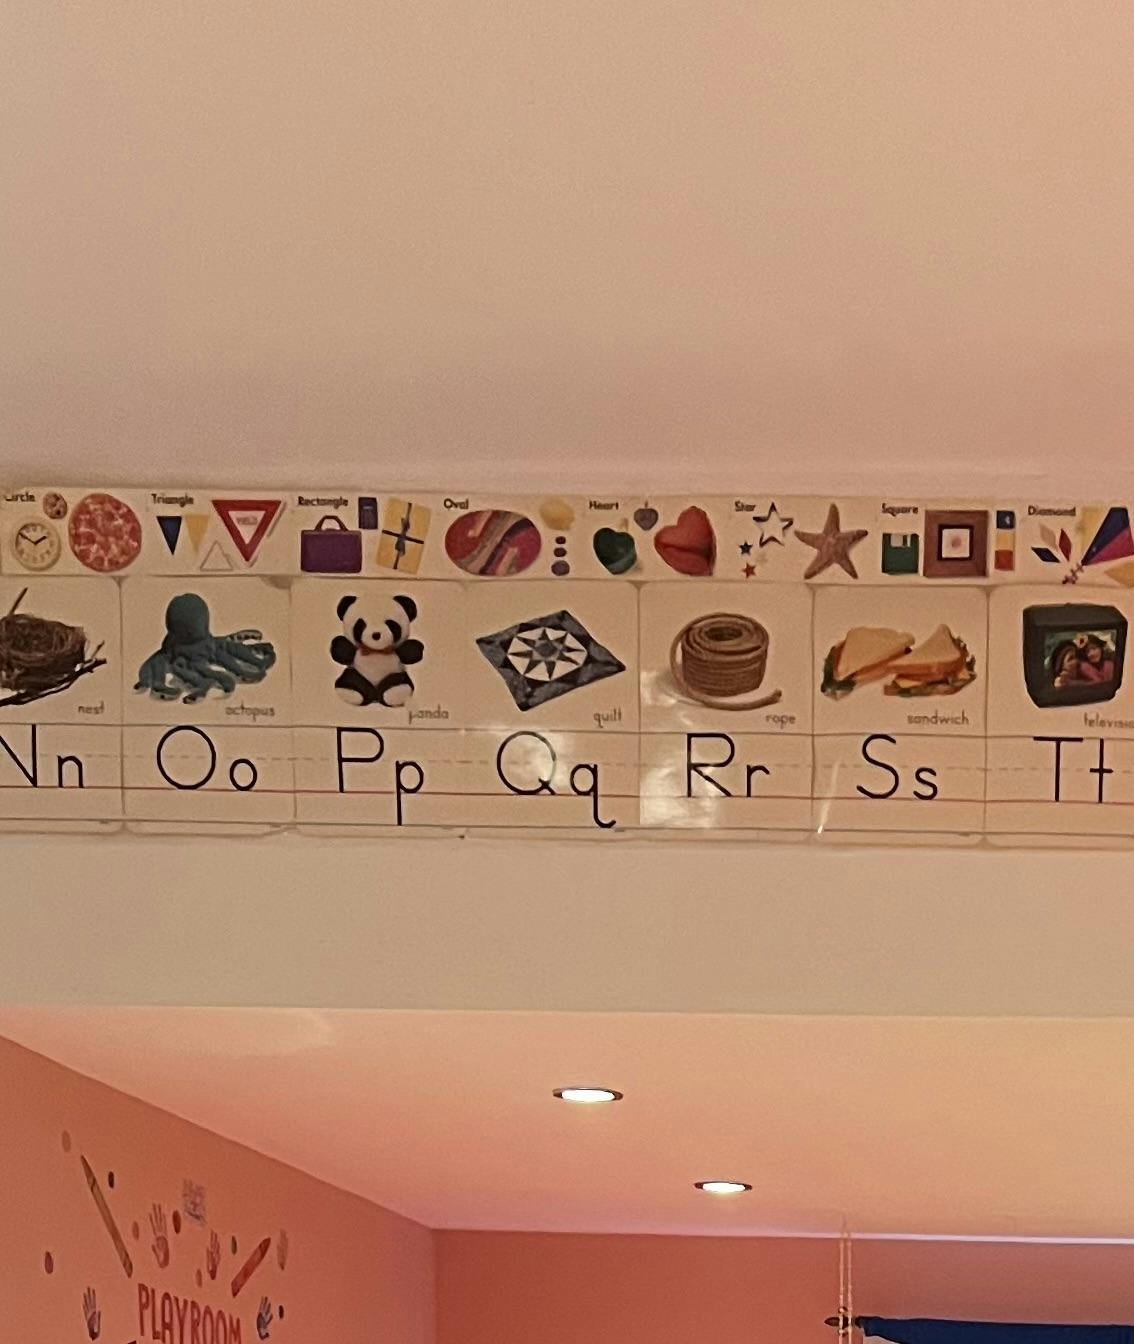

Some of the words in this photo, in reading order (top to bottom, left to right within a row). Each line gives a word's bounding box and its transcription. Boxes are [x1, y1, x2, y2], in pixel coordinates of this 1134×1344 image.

[151, 493, 194, 507] Triangle
[298, 496, 349, 509] Rectangle
[444, 498, 469, 510] Oval
[589, 500, 619, 511] Heart
[734, 501, 756, 513] Star
[881, 503, 919, 517] Square
[1027, 506, 1076, 517] Diamond
[77, 702, 105, 715] nest
[225, 704, 276, 721] octopus
[408, 706, 449, 724] panda
[593, 708, 623, 729] quilt
[765, 714, 796, 729] rope
[907, 711, 970, 726] sandwich
